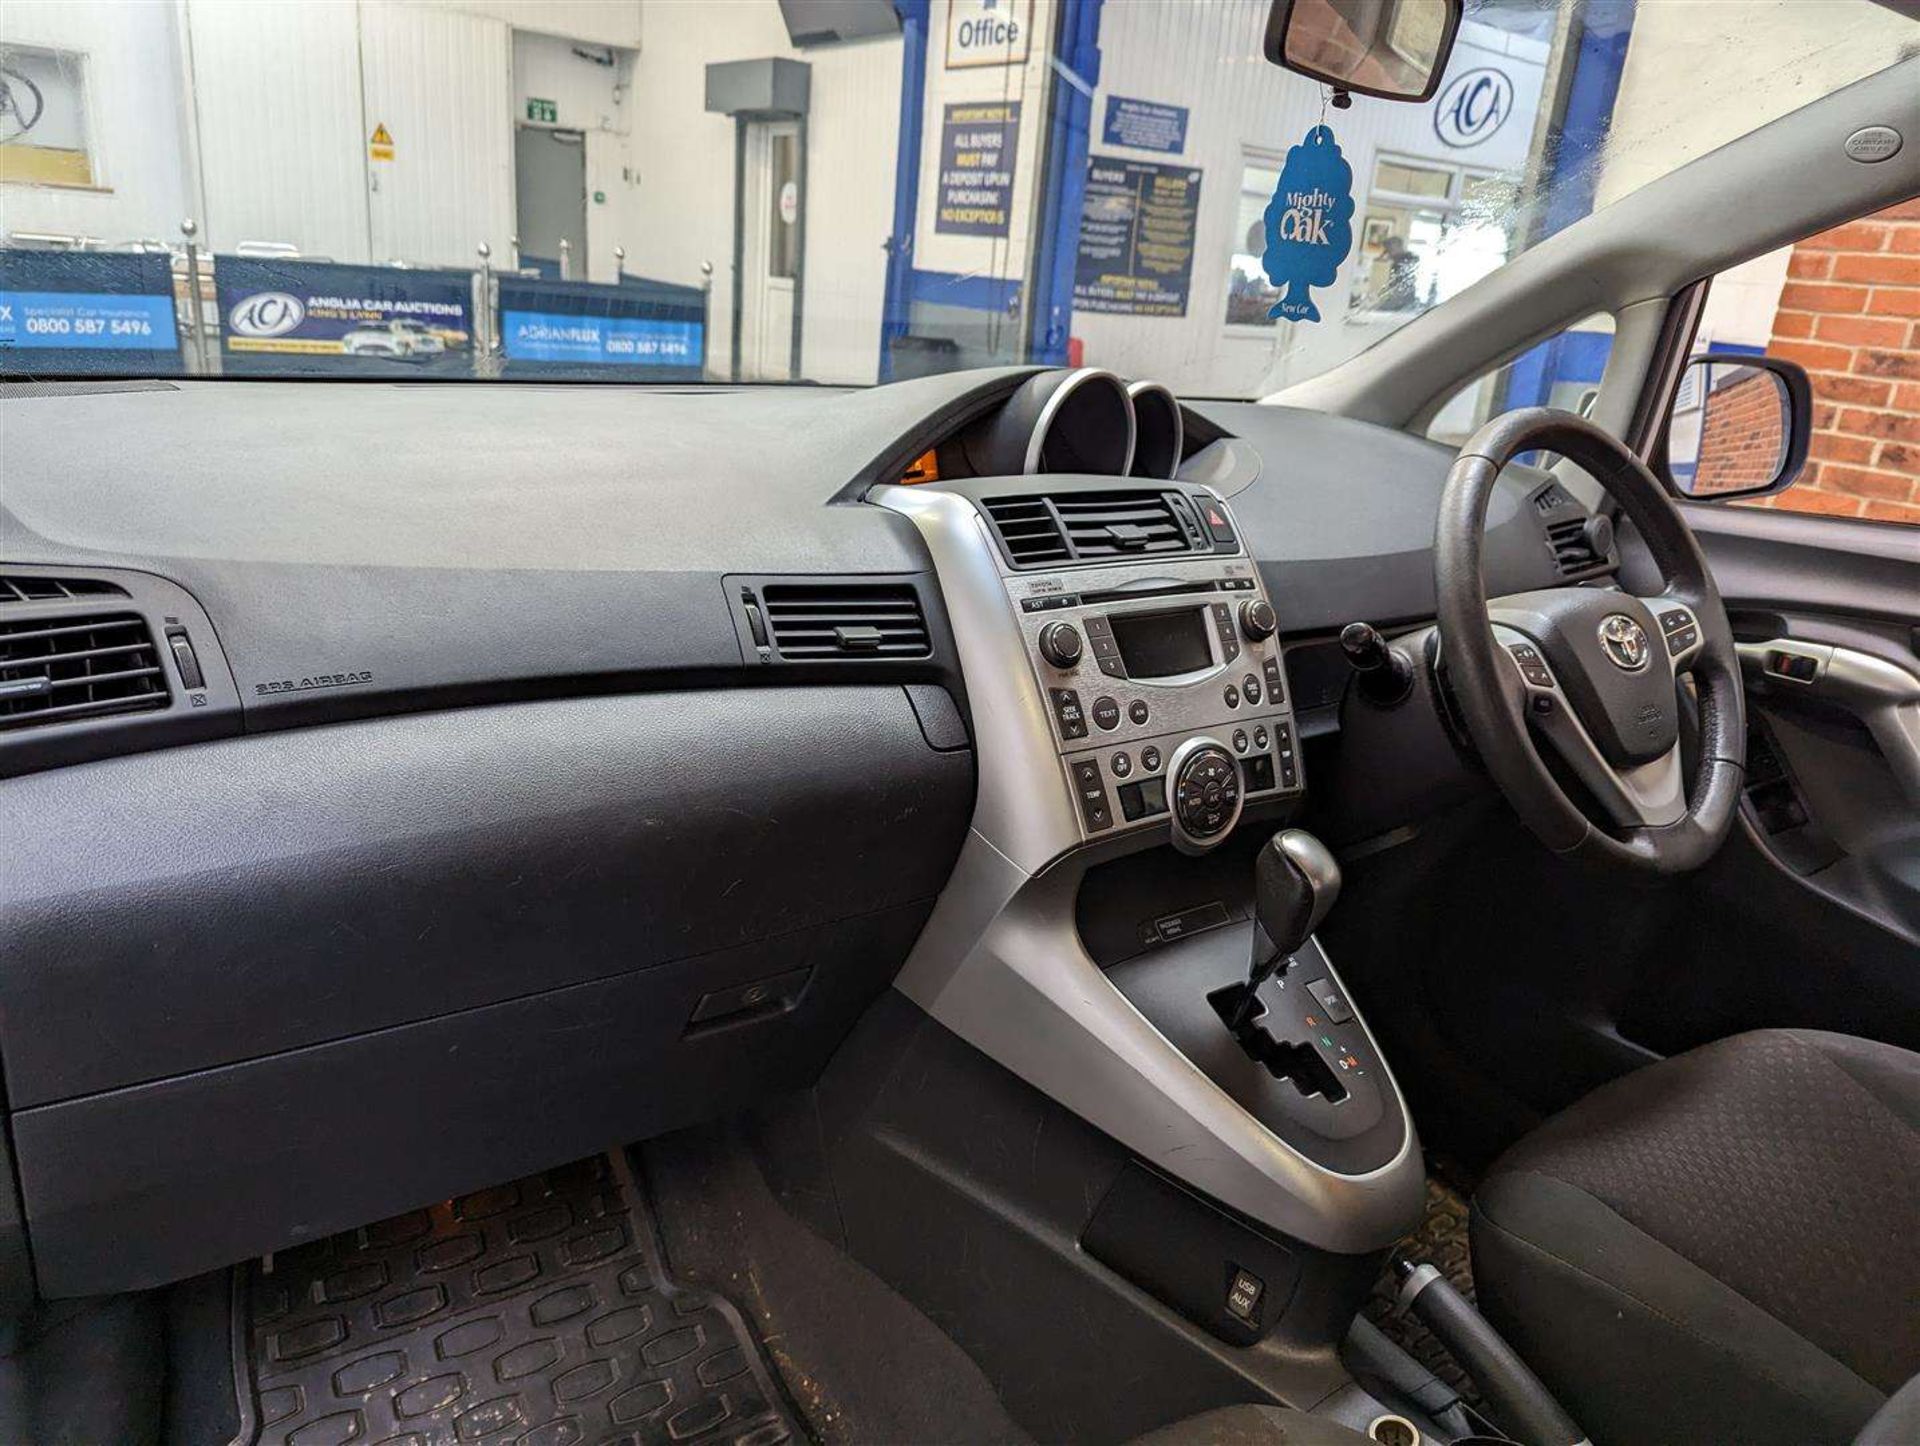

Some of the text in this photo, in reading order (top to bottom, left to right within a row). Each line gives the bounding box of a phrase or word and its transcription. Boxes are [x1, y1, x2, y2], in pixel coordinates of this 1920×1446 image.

[959, 18, 1018, 48] Office
[954, 133, 1002, 148] ALL BUYERS
[981, 152, 998, 167] PAY
[950, 172, 983, 187] DEPOSIT
[984, 171, 1010, 186] UPON
[1286, 188, 1336, 217] Mighty
[1281, 208, 1331, 245] Oak
[308, 296, 463, 316] ANGLIA CAR AUCTIONS
[26, 318, 70, 334] 0800
[74, 319, 105, 334] 587
[111, 319, 151, 335] 5496
[606, 340, 635, 354] 0800
[300, 671, 373, 688] AIRBAG
[1099, 709, 1117, 718] TEXT
[1135, 708, 1146, 716] AM
[1086, 789, 1101, 799] TEMP
[1277, 979, 1285, 990] P
[1306, 1016, 1317, 1027] R
[1321, 1036, 1333, 1048] N
[1238, 1278, 1256, 1296] USB
[1231, 1293, 1251, 1310] AUX
